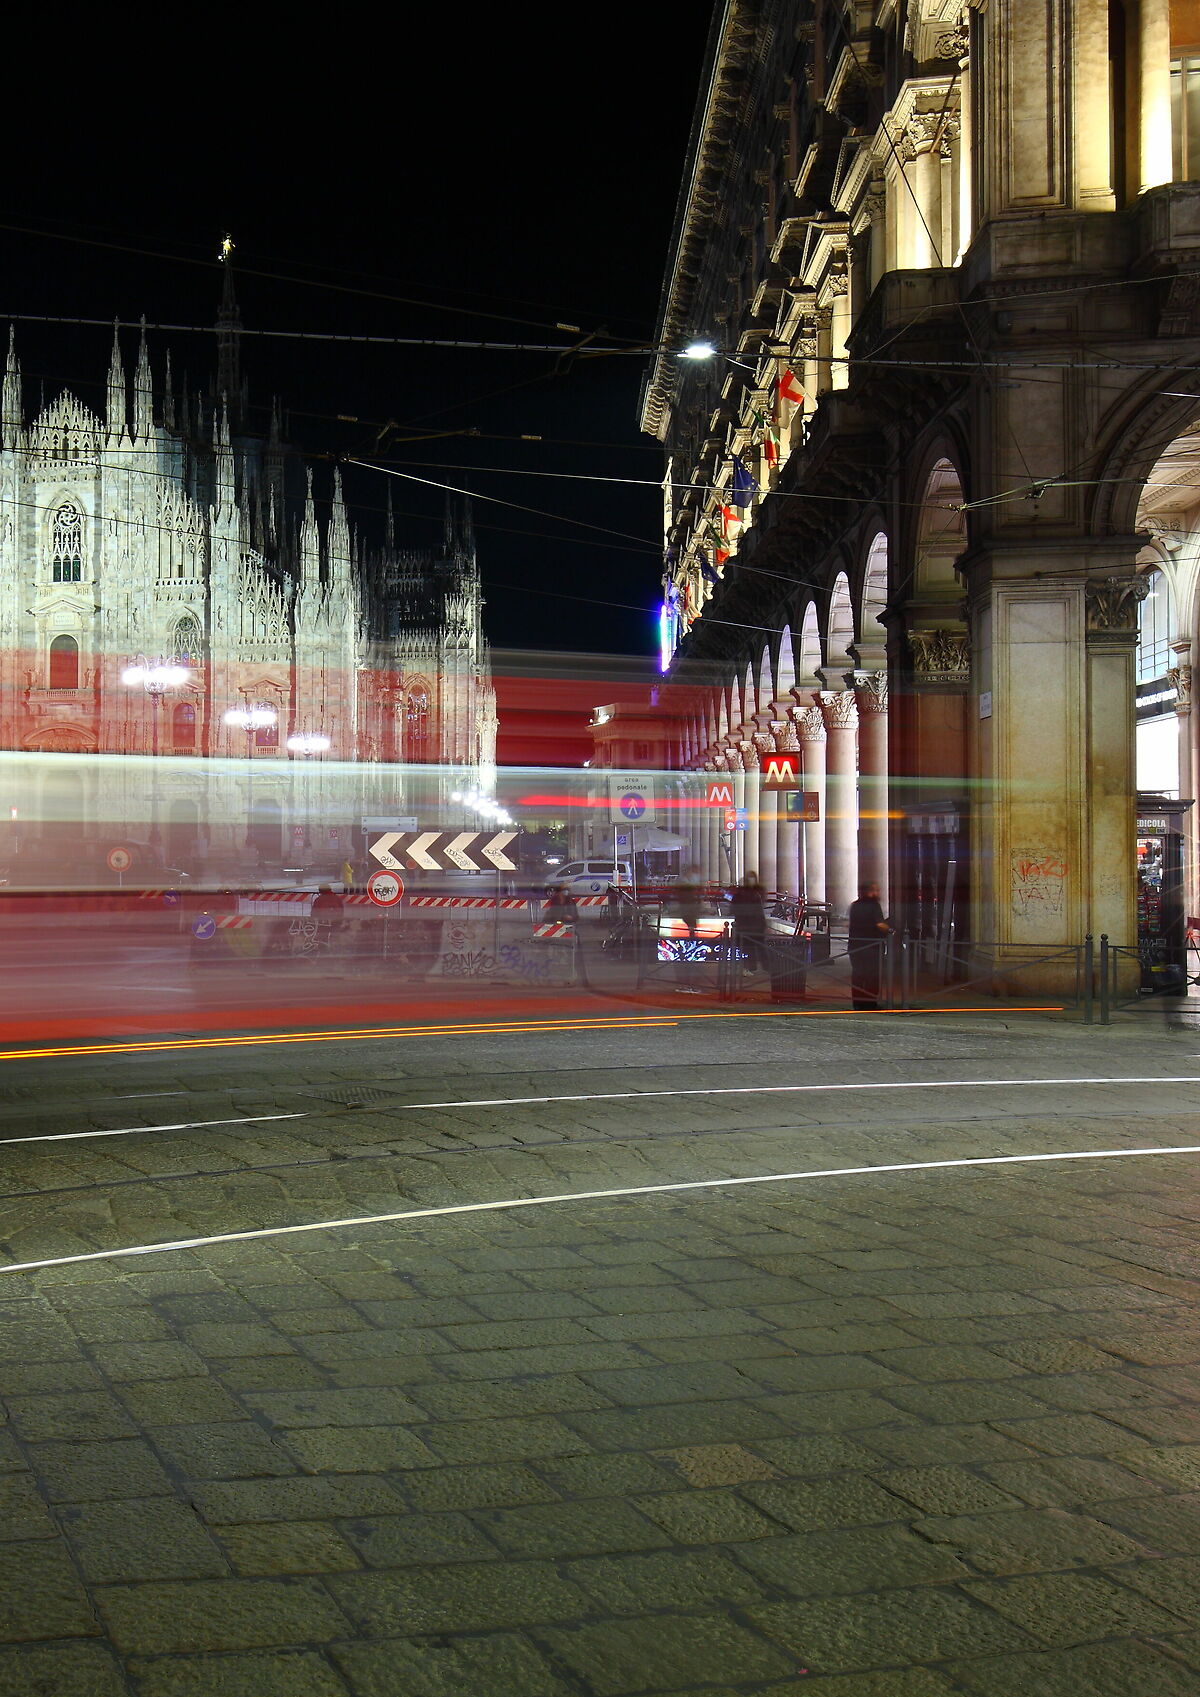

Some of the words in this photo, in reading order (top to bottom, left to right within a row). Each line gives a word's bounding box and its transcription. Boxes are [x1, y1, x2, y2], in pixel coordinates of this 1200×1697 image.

[765, 761, 796, 783] M
[709, 786, 732, 802] M
[1136, 819, 1166, 828] EDICOLA
